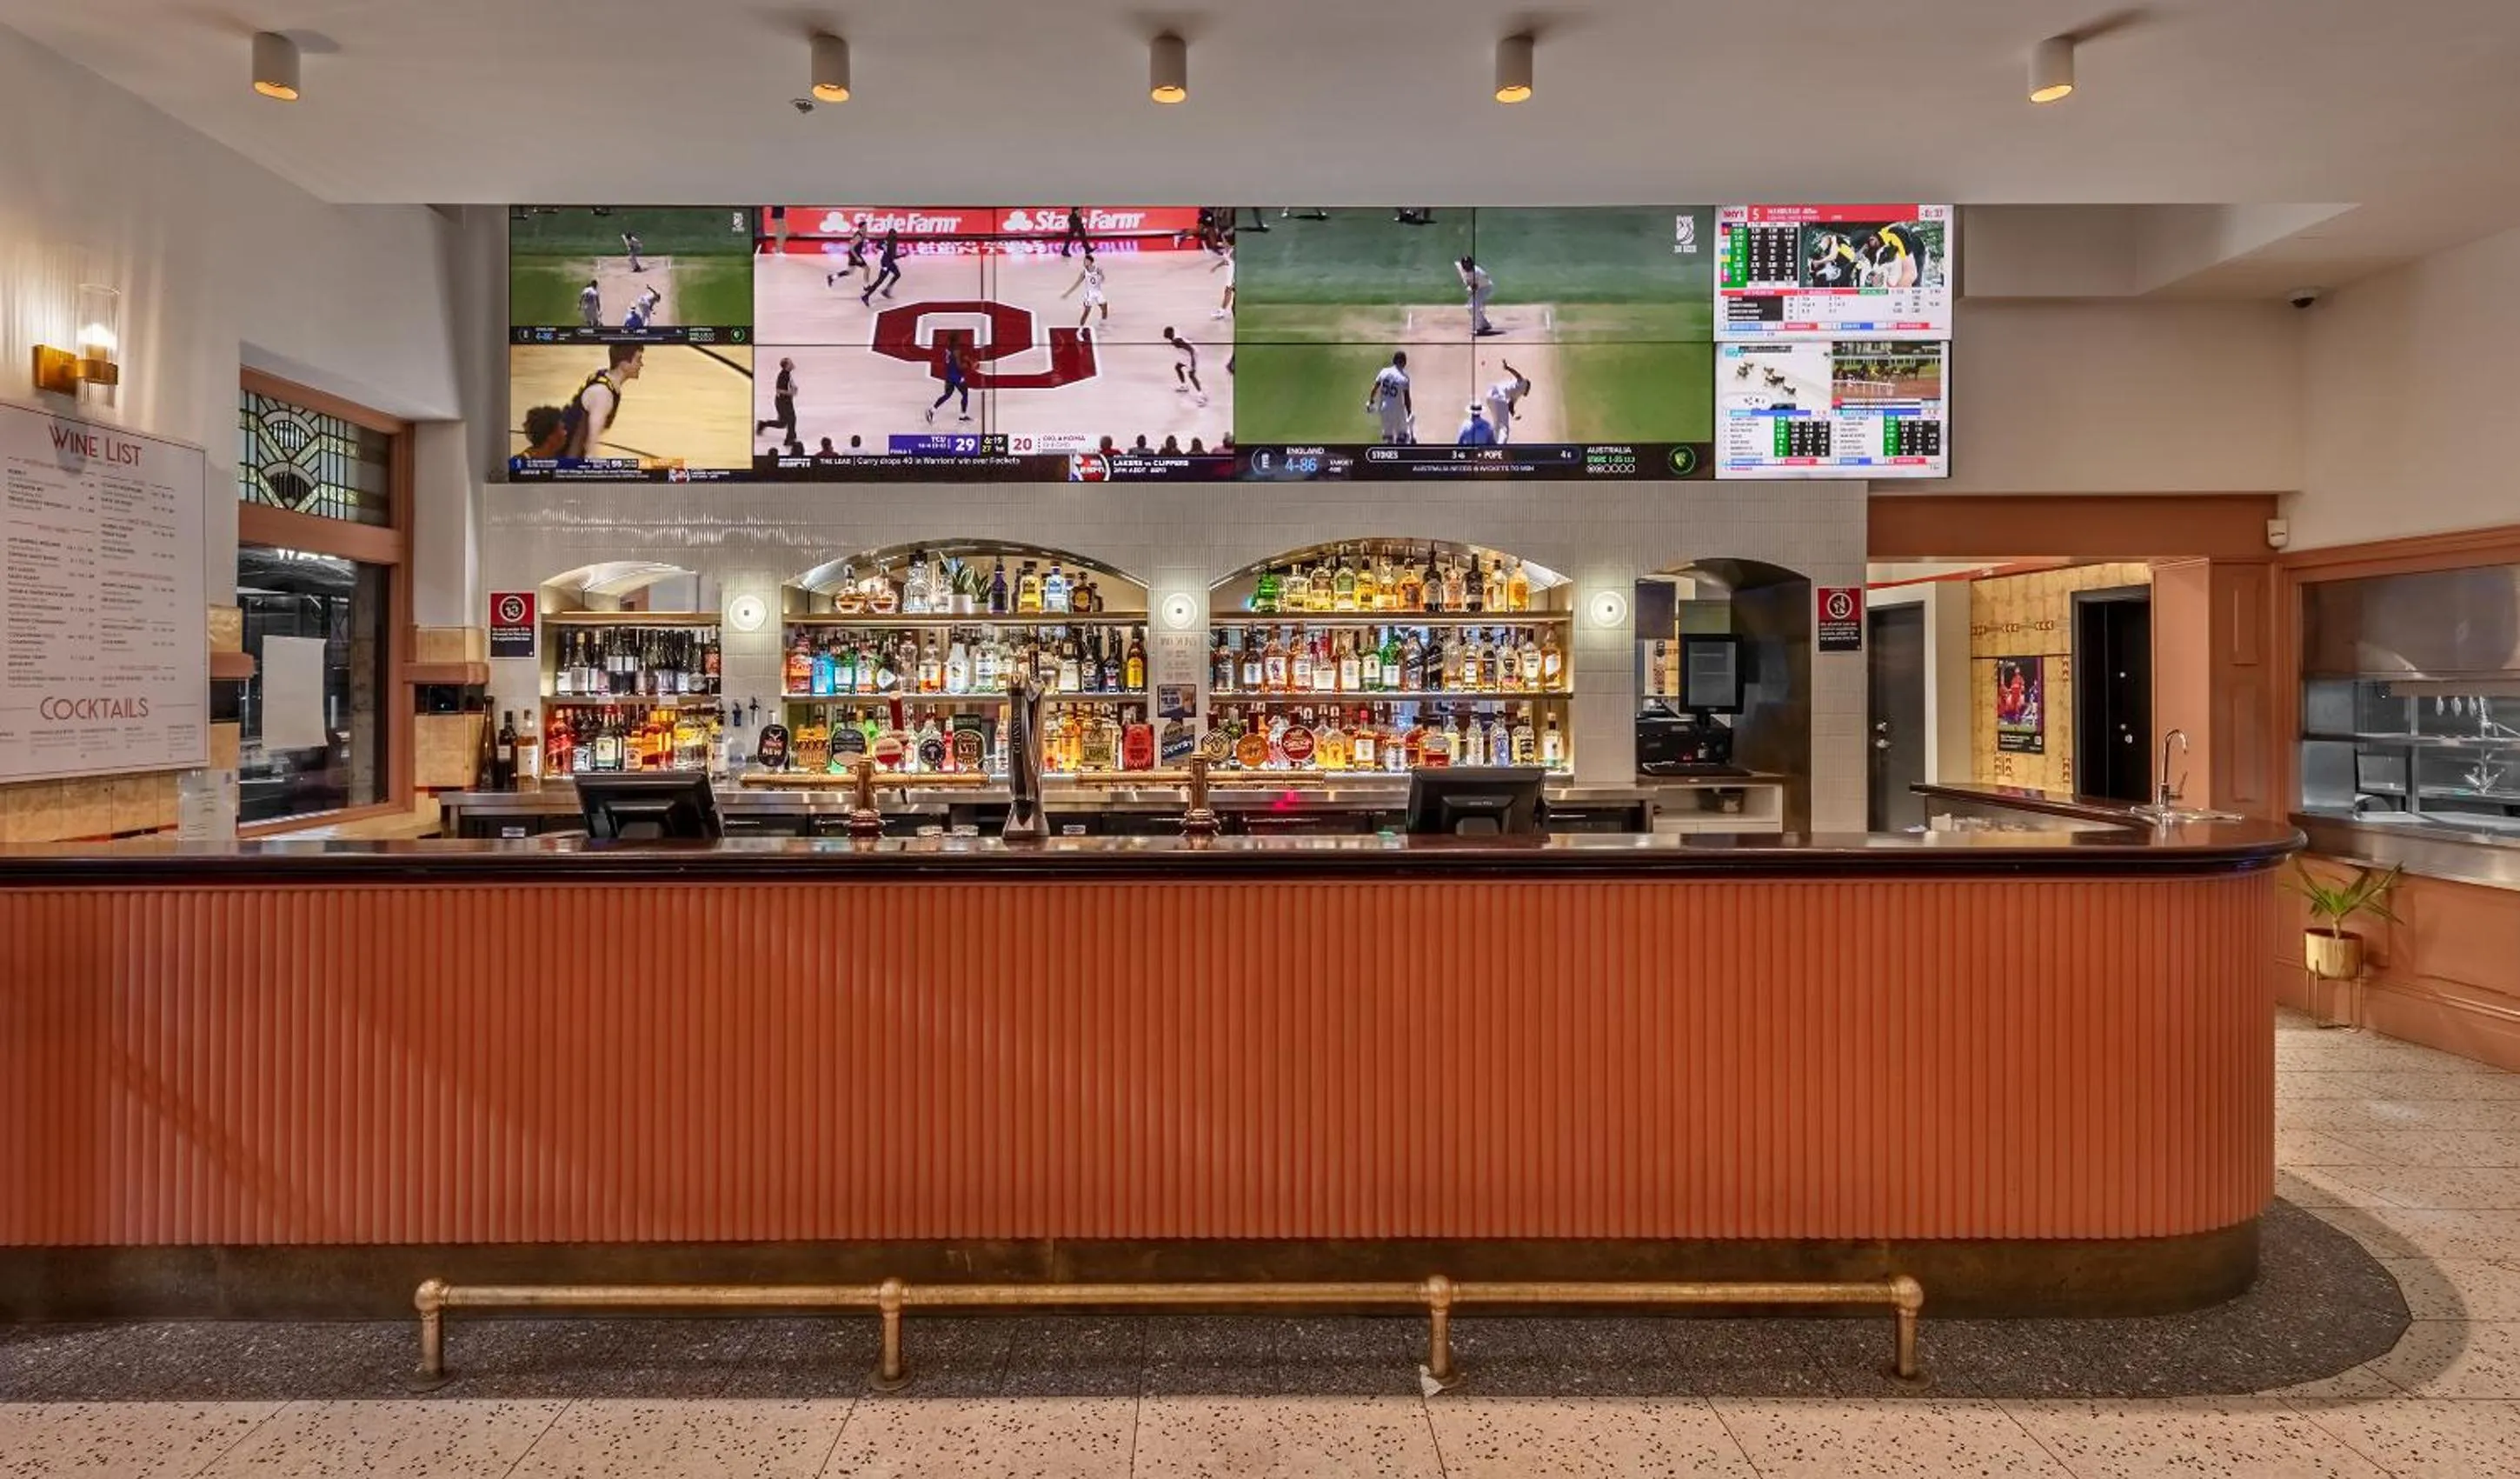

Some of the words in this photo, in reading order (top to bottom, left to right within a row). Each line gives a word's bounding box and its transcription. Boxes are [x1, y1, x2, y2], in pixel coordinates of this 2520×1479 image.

[49, 423, 98, 458] WINE
[106, 437, 142, 467] LIST
[955, 437, 976, 452] 29
[1014, 437, 1033, 450] 20
[857, 456, 878, 466] Curry
[1286, 457, 1317, 471] 4-86
[40, 696, 149, 721] COCKTAILS
[795, 739, 829, 749] XXXX
